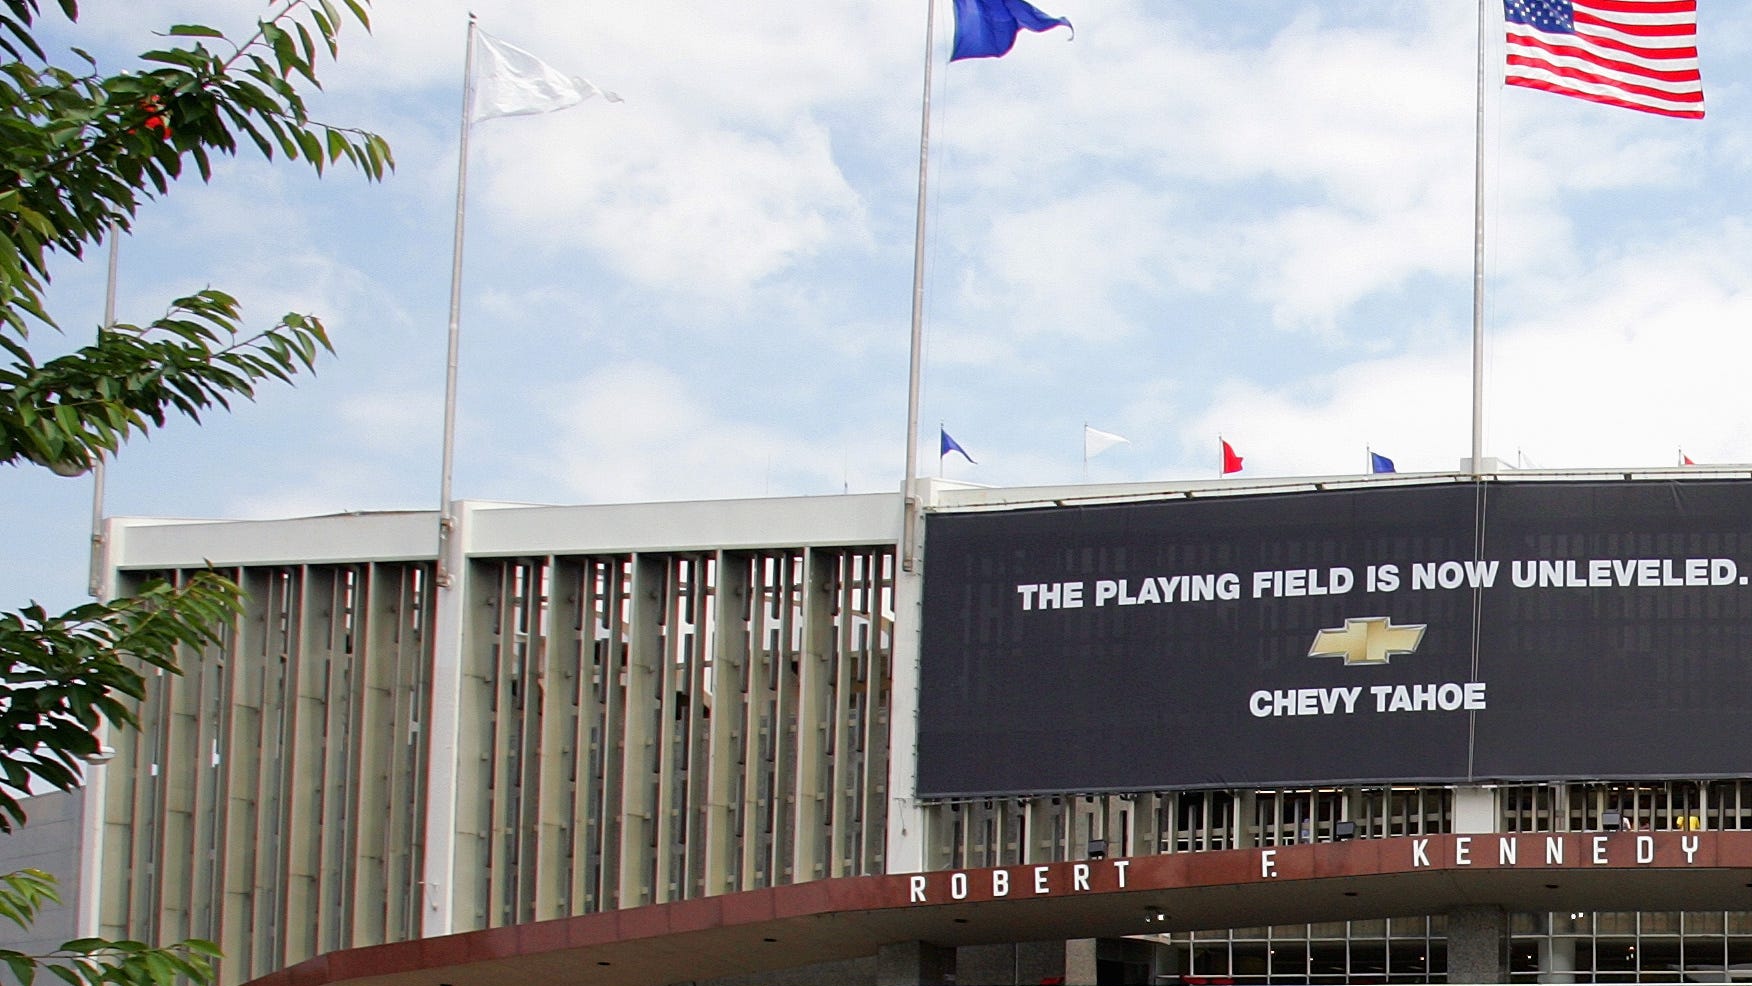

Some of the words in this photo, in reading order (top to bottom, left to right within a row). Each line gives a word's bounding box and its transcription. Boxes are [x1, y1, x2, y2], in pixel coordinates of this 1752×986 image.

[1017, 582, 1084, 611] THE
[1095, 573, 1241, 607] PLAYING
[1252, 567, 1354, 599] FIELD
[1366, 564, 1401, 592] IS
[1412, 560, 1499, 590] NOW
[1511, 558, 1749, 588] UNLEVELED.
[1249, 687, 1362, 717] CHEVY
[1371, 682, 1487, 712] TAHOE
[910, 860, 1130, 903] ROBERT
[1261, 850, 1277, 878] F.
[1412, 835, 1699, 868] KENNEDY
